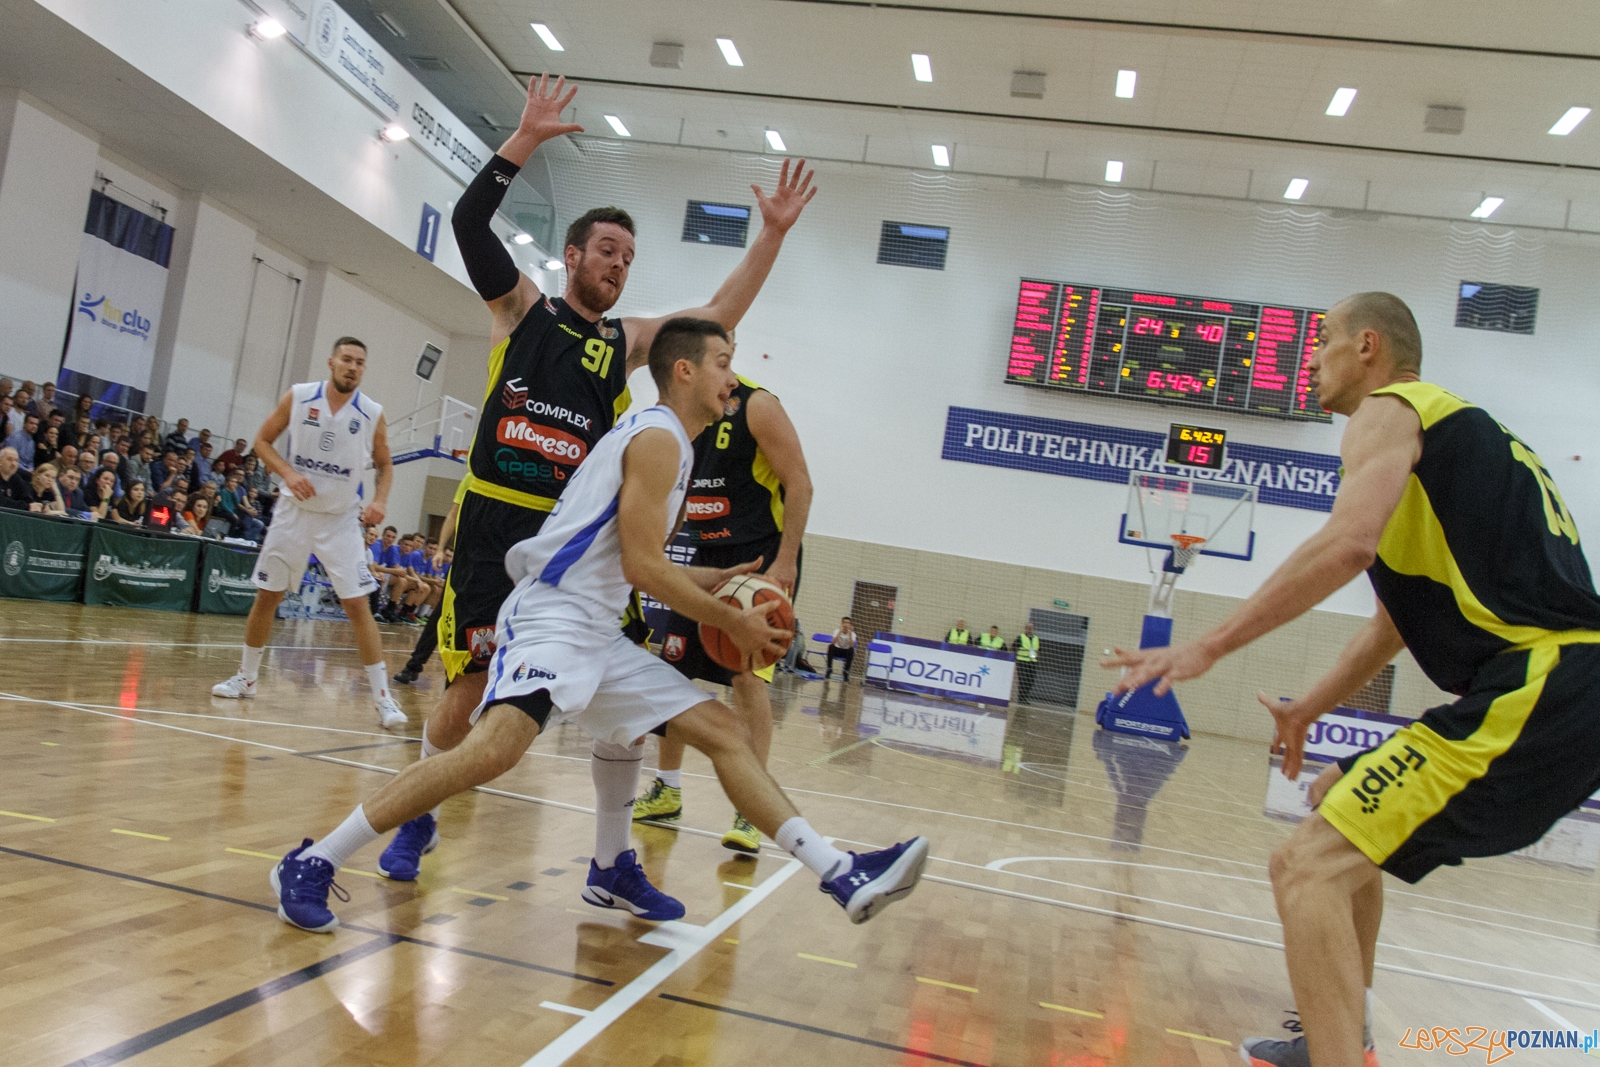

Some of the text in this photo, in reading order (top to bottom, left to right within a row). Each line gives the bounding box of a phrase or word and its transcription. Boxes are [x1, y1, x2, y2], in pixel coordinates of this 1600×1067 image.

[423, 214, 436, 255] 1
[1133, 316, 1165, 336] 24
[1195, 323, 1225, 343] 40
[581, 338, 614, 380] 91
[525, 399, 591, 431] COMPLEX
[504, 420, 581, 461] Moreso
[715, 421, 733, 450] 6
[963, 422, 1168, 474] POLITECHNIKA
[1187, 445, 1211, 464] 15
